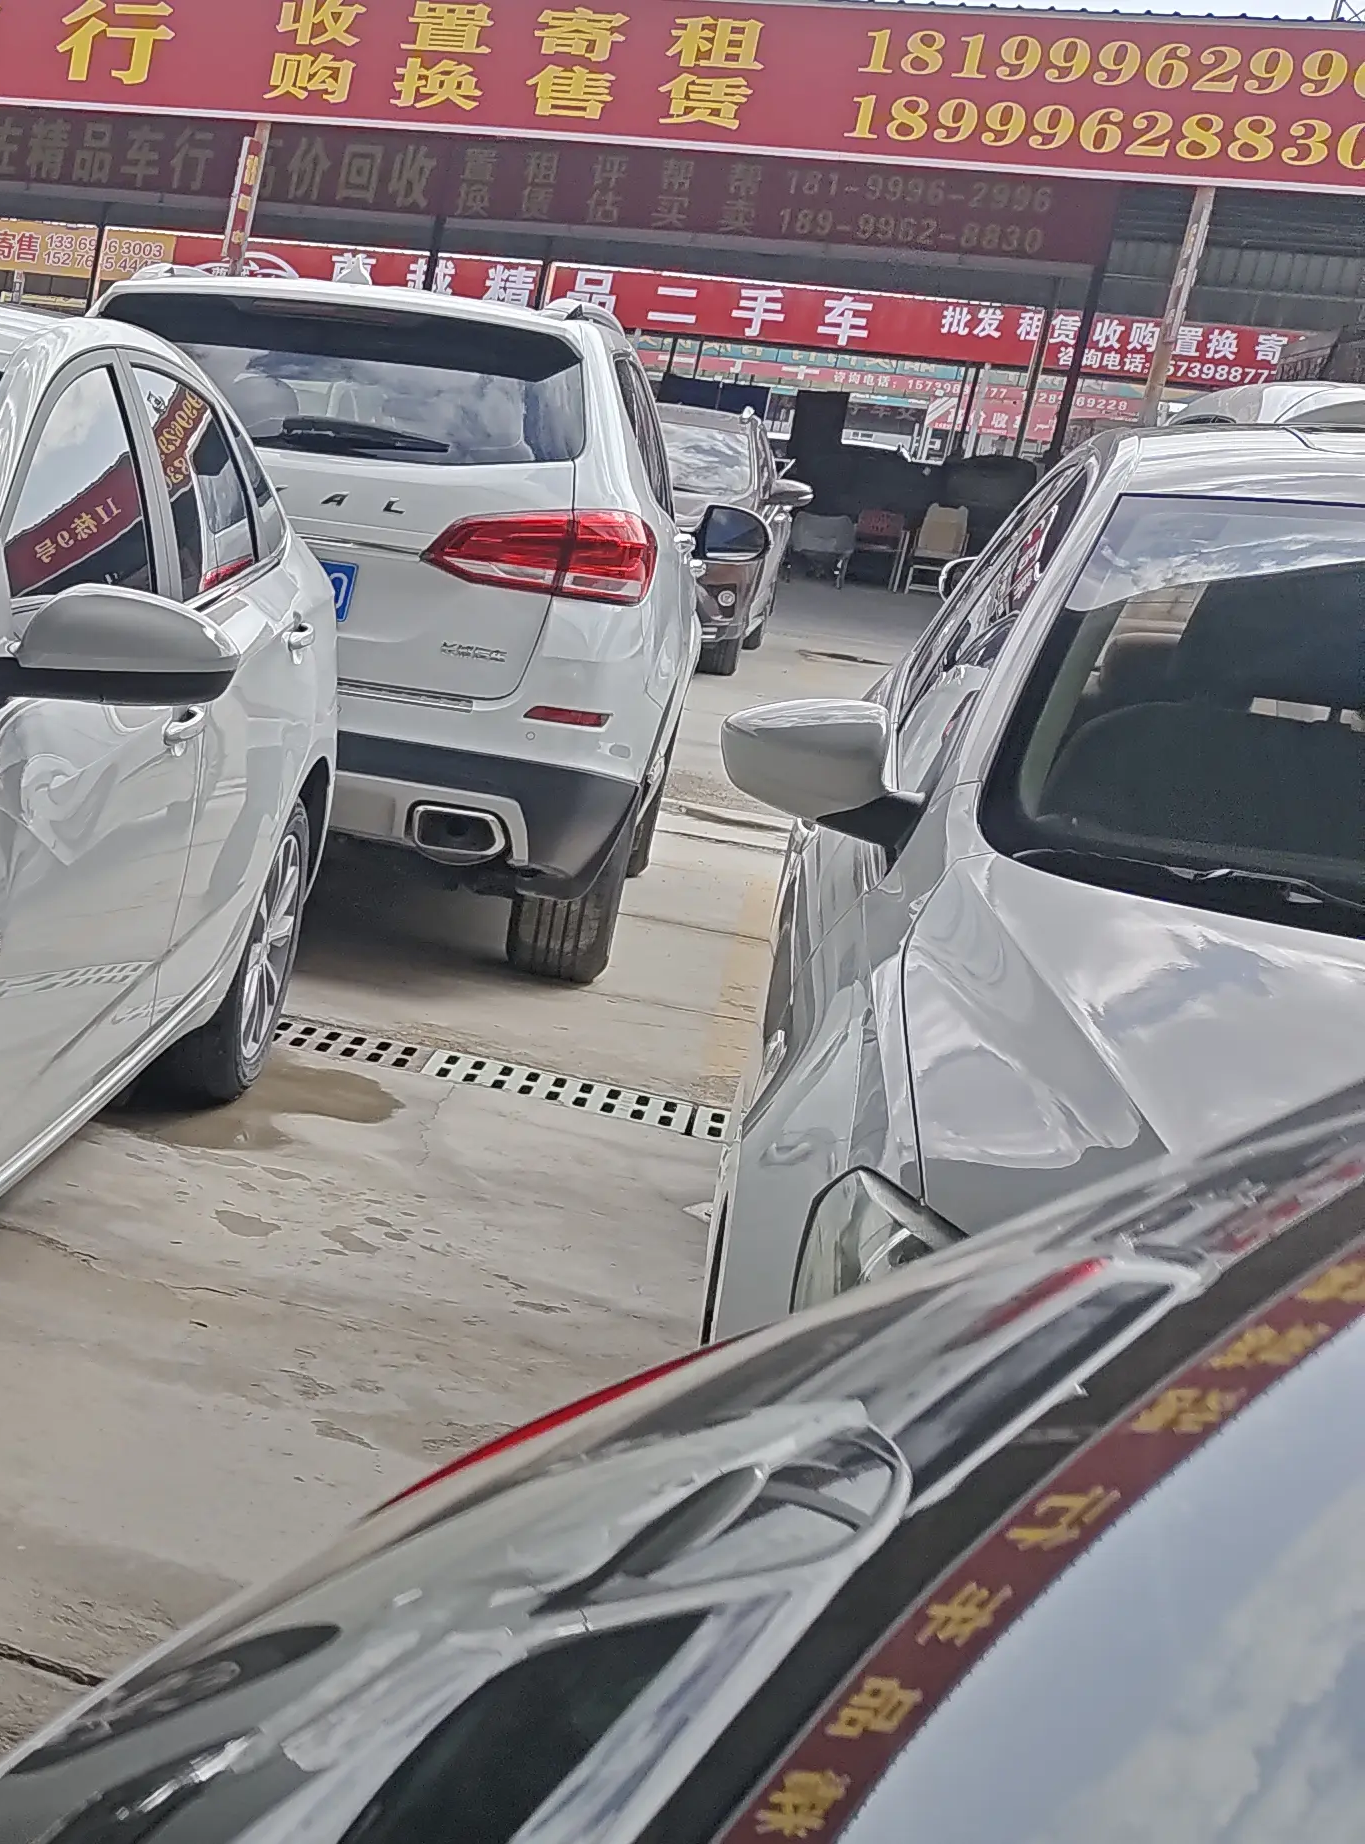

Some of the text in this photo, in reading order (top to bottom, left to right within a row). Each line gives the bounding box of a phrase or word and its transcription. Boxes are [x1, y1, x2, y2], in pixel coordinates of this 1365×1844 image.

[264, 0, 366, 103] 收购
[389, 3, 495, 111] 置换
[525, 8, 631, 120] 寄售
[657, 16, 765, 130] 租赁
[857, 29, 1365, 97] 1819996299
[43, 250, 71, 267] 152
[75, 253, 116, 271] 765
[46, 233, 164, 258] 133 696 3003
[939, 306, 1005, 339] 批发
[1017, 310, 1082, 346] 租赁
[1093, 319, 1161, 352] 收购
[1175, 327, 1239, 361] 置换
[1163, 359, 1277, 384] 57398877
